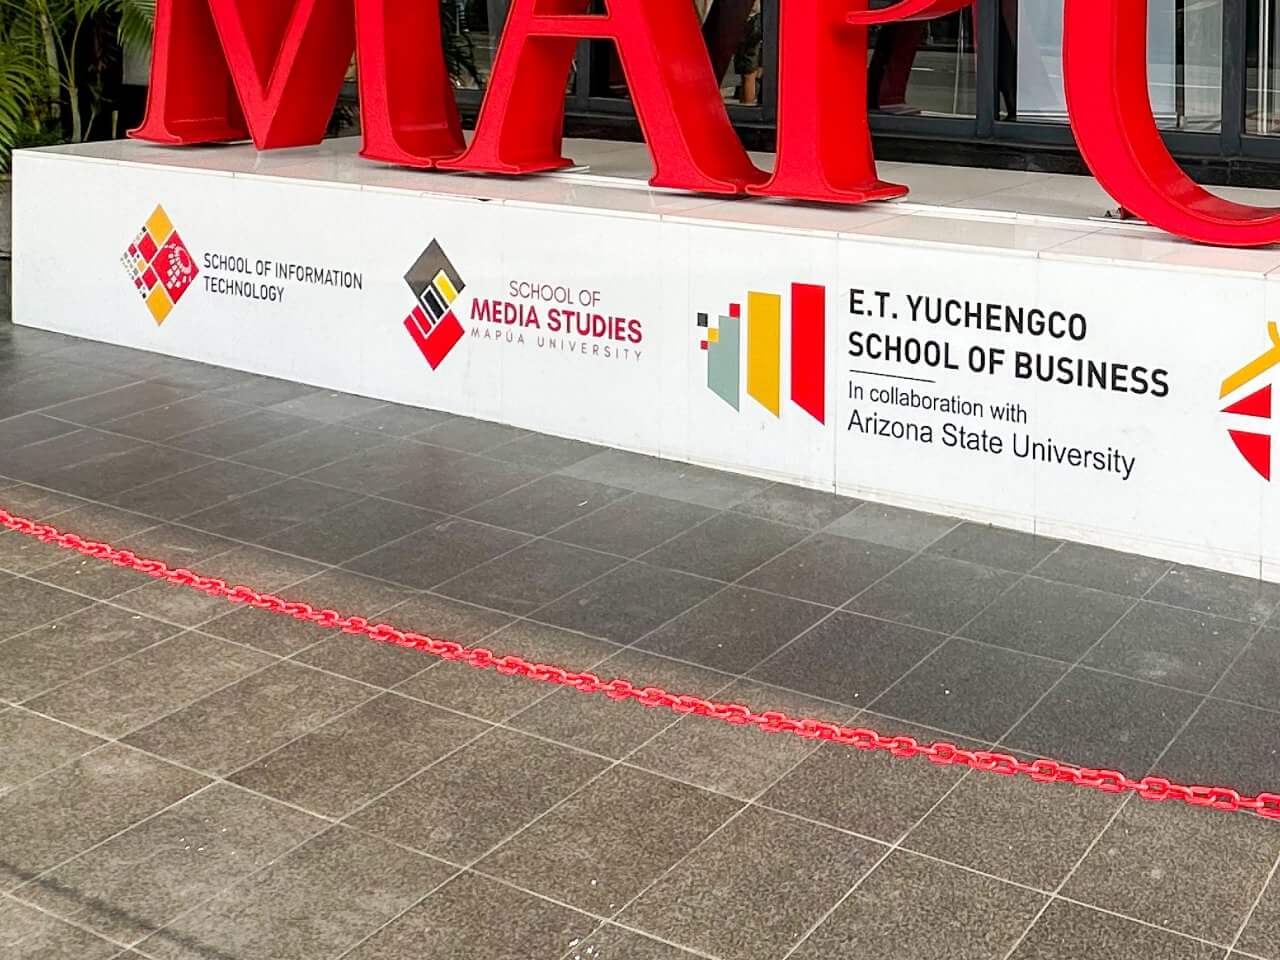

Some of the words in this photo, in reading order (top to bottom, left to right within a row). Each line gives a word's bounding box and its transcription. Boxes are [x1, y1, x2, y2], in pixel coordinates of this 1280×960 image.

[204, 252, 251, 274] SCHOOL
[256, 261, 272, 276] OF
[275, 263, 363, 290] INFORMATION
[204, 275, 284, 302] TECHNOLOGY
[509, 280, 574, 304] SCHOOL
[579, 289, 601, 307] OF
[849, 288, 898, 319] E.T.
[906, 294, 1087, 340] YUCHENGCO
[471, 297, 539, 328] MEDIA
[547, 308, 643, 344] STUDIES
[471, 327, 525, 344] MAPÚA
[536, 336, 643, 360] UNIVERSITY
[849, 331, 959, 370] SCHOOL
[968, 346, 1005, 375] OF
[1015, 352, 1169, 397] BUSINESS
[849, 381, 864, 400] In
[869, 384, 984, 418] collaboration
[990, 401, 1028, 425] with
[848, 409, 933, 443] Arizona
[941, 424, 1003, 455] State
[1012, 435, 1136, 481] University
